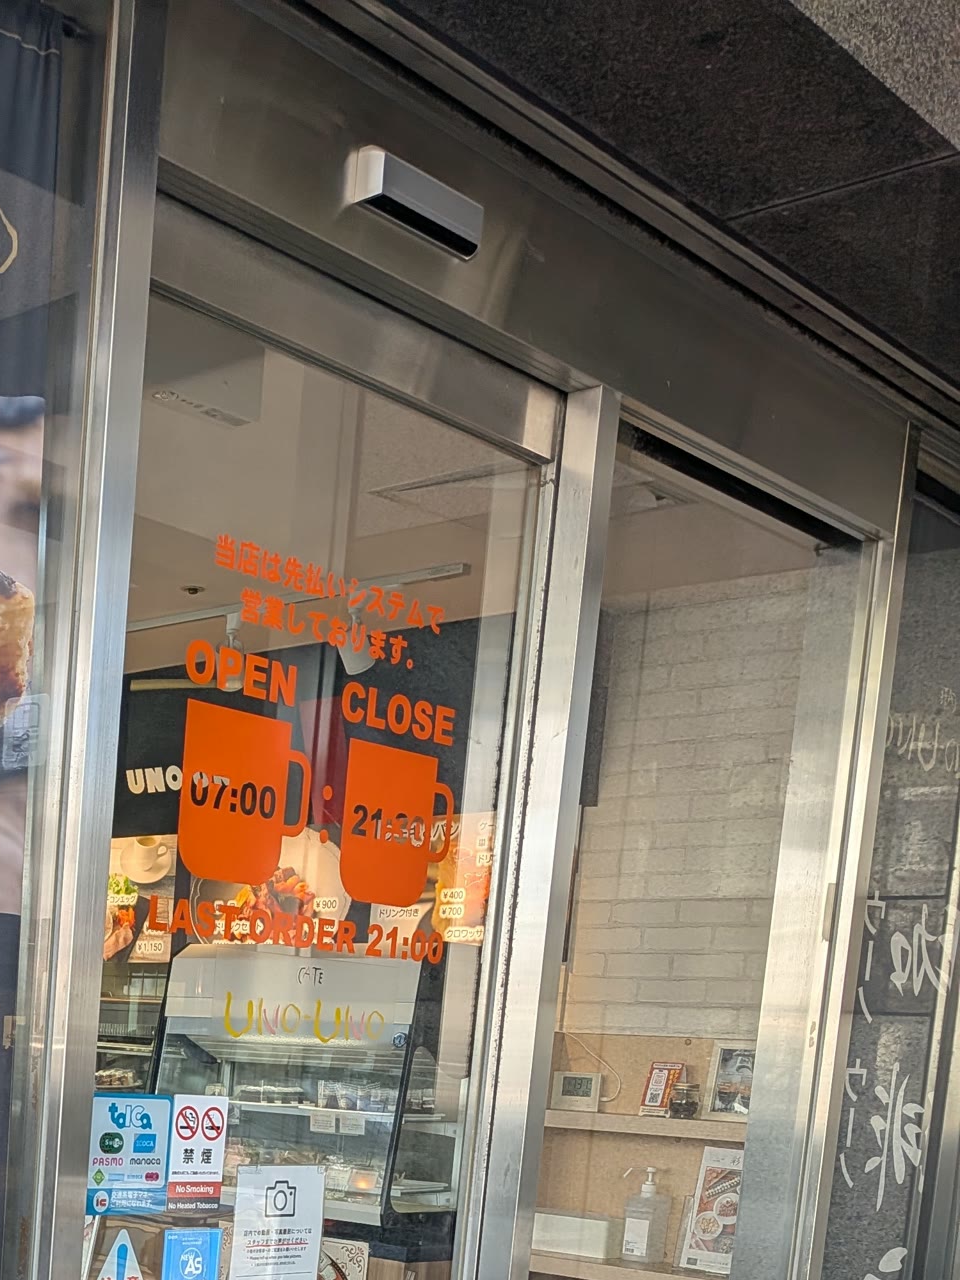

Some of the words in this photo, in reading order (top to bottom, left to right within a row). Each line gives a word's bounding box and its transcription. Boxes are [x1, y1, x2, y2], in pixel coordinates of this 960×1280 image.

[214, 534, 444, 635] 当店は先払いシステムで
[240, 588, 414, 669] 営業しております。
[186, 640, 297, 707] OPEN
[342, 682, 456, 746] CLOSE
[190, 771, 276, 820] 07:00
[351, 804, 425, 846] 21:30
[443, 891, 464, 899] ¥400
[316, 900, 337, 909] ¥900
[442, 907, 462, 915] ¥700
[378, 909, 419, 918] ドリンク付き
[148, 894, 243, 942] LAST
[249, 909, 357, 955] ORDER
[365, 923, 444, 965] 21:00
[92, 1157, 124, 1166] PASMO
[182, 1148, 213, 1164] 禁煙
[175, 1185, 185, 1193] No
[186, 1184, 214, 1195] Smoking
[168, 1202, 176, 1210] No
[184, 1257, 203, 1275] AS
